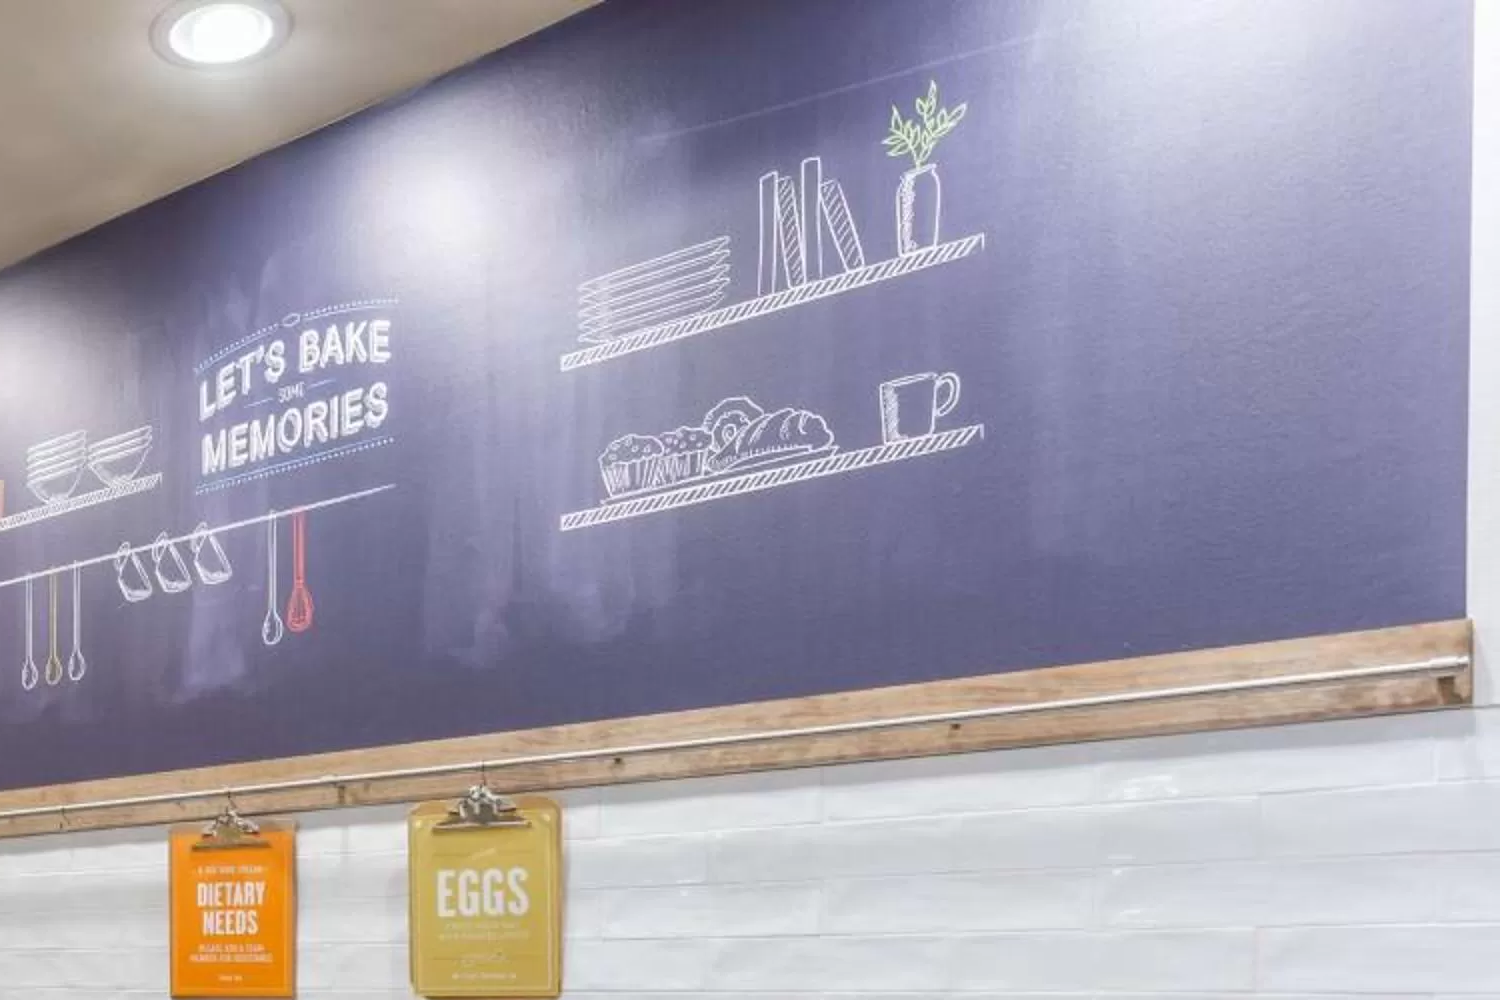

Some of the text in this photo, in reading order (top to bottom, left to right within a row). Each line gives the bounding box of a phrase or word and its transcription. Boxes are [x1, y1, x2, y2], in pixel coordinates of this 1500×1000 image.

[199, 319, 392, 422] LET'S BAKE
[201, 381, 389, 476] MEMORIES
[196, 881, 266, 907] DIETARY
[436, 867, 530, 918] EGGS
[203, 910, 259, 935] NEEDS
